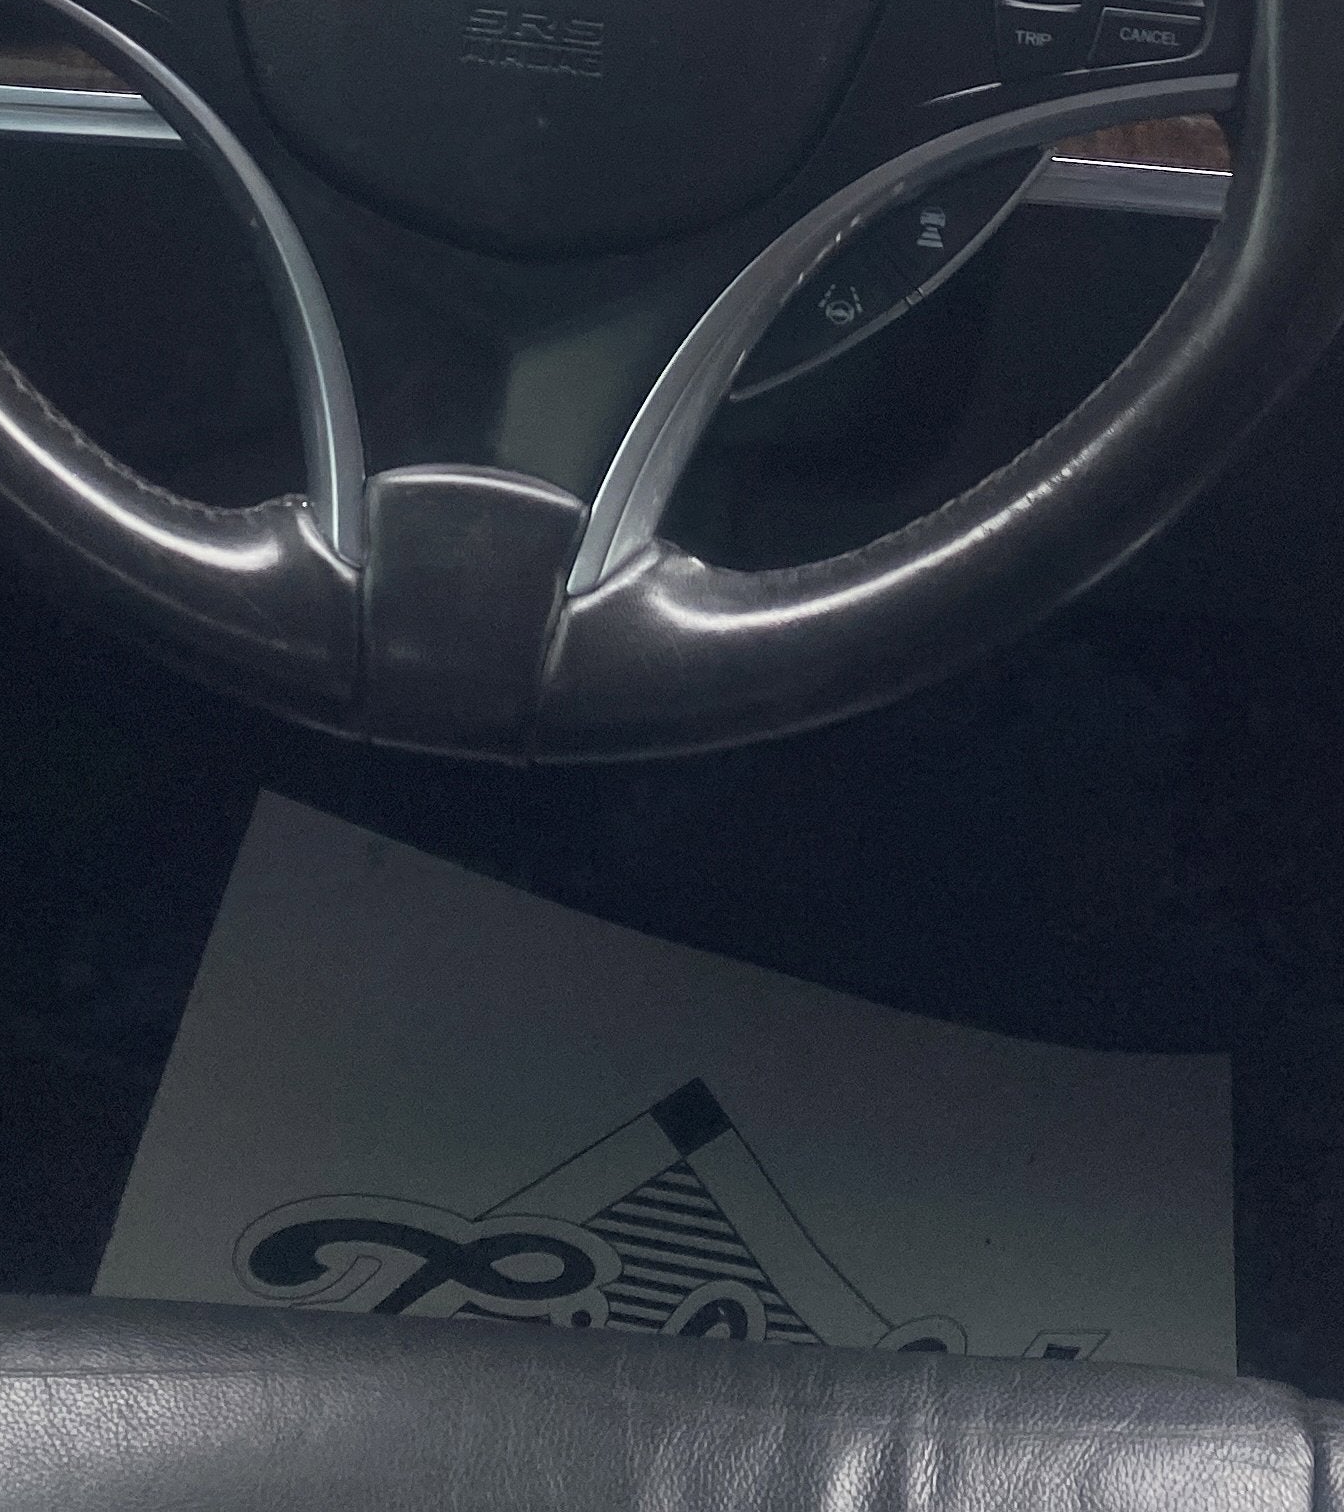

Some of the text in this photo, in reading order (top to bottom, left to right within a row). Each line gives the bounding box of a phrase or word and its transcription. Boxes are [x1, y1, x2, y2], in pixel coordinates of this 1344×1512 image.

[464, 7, 605, 46] SRS
[1119, 26, 1180, 47] CANCEL
[1015, 29, 1053, 47] TRIP
